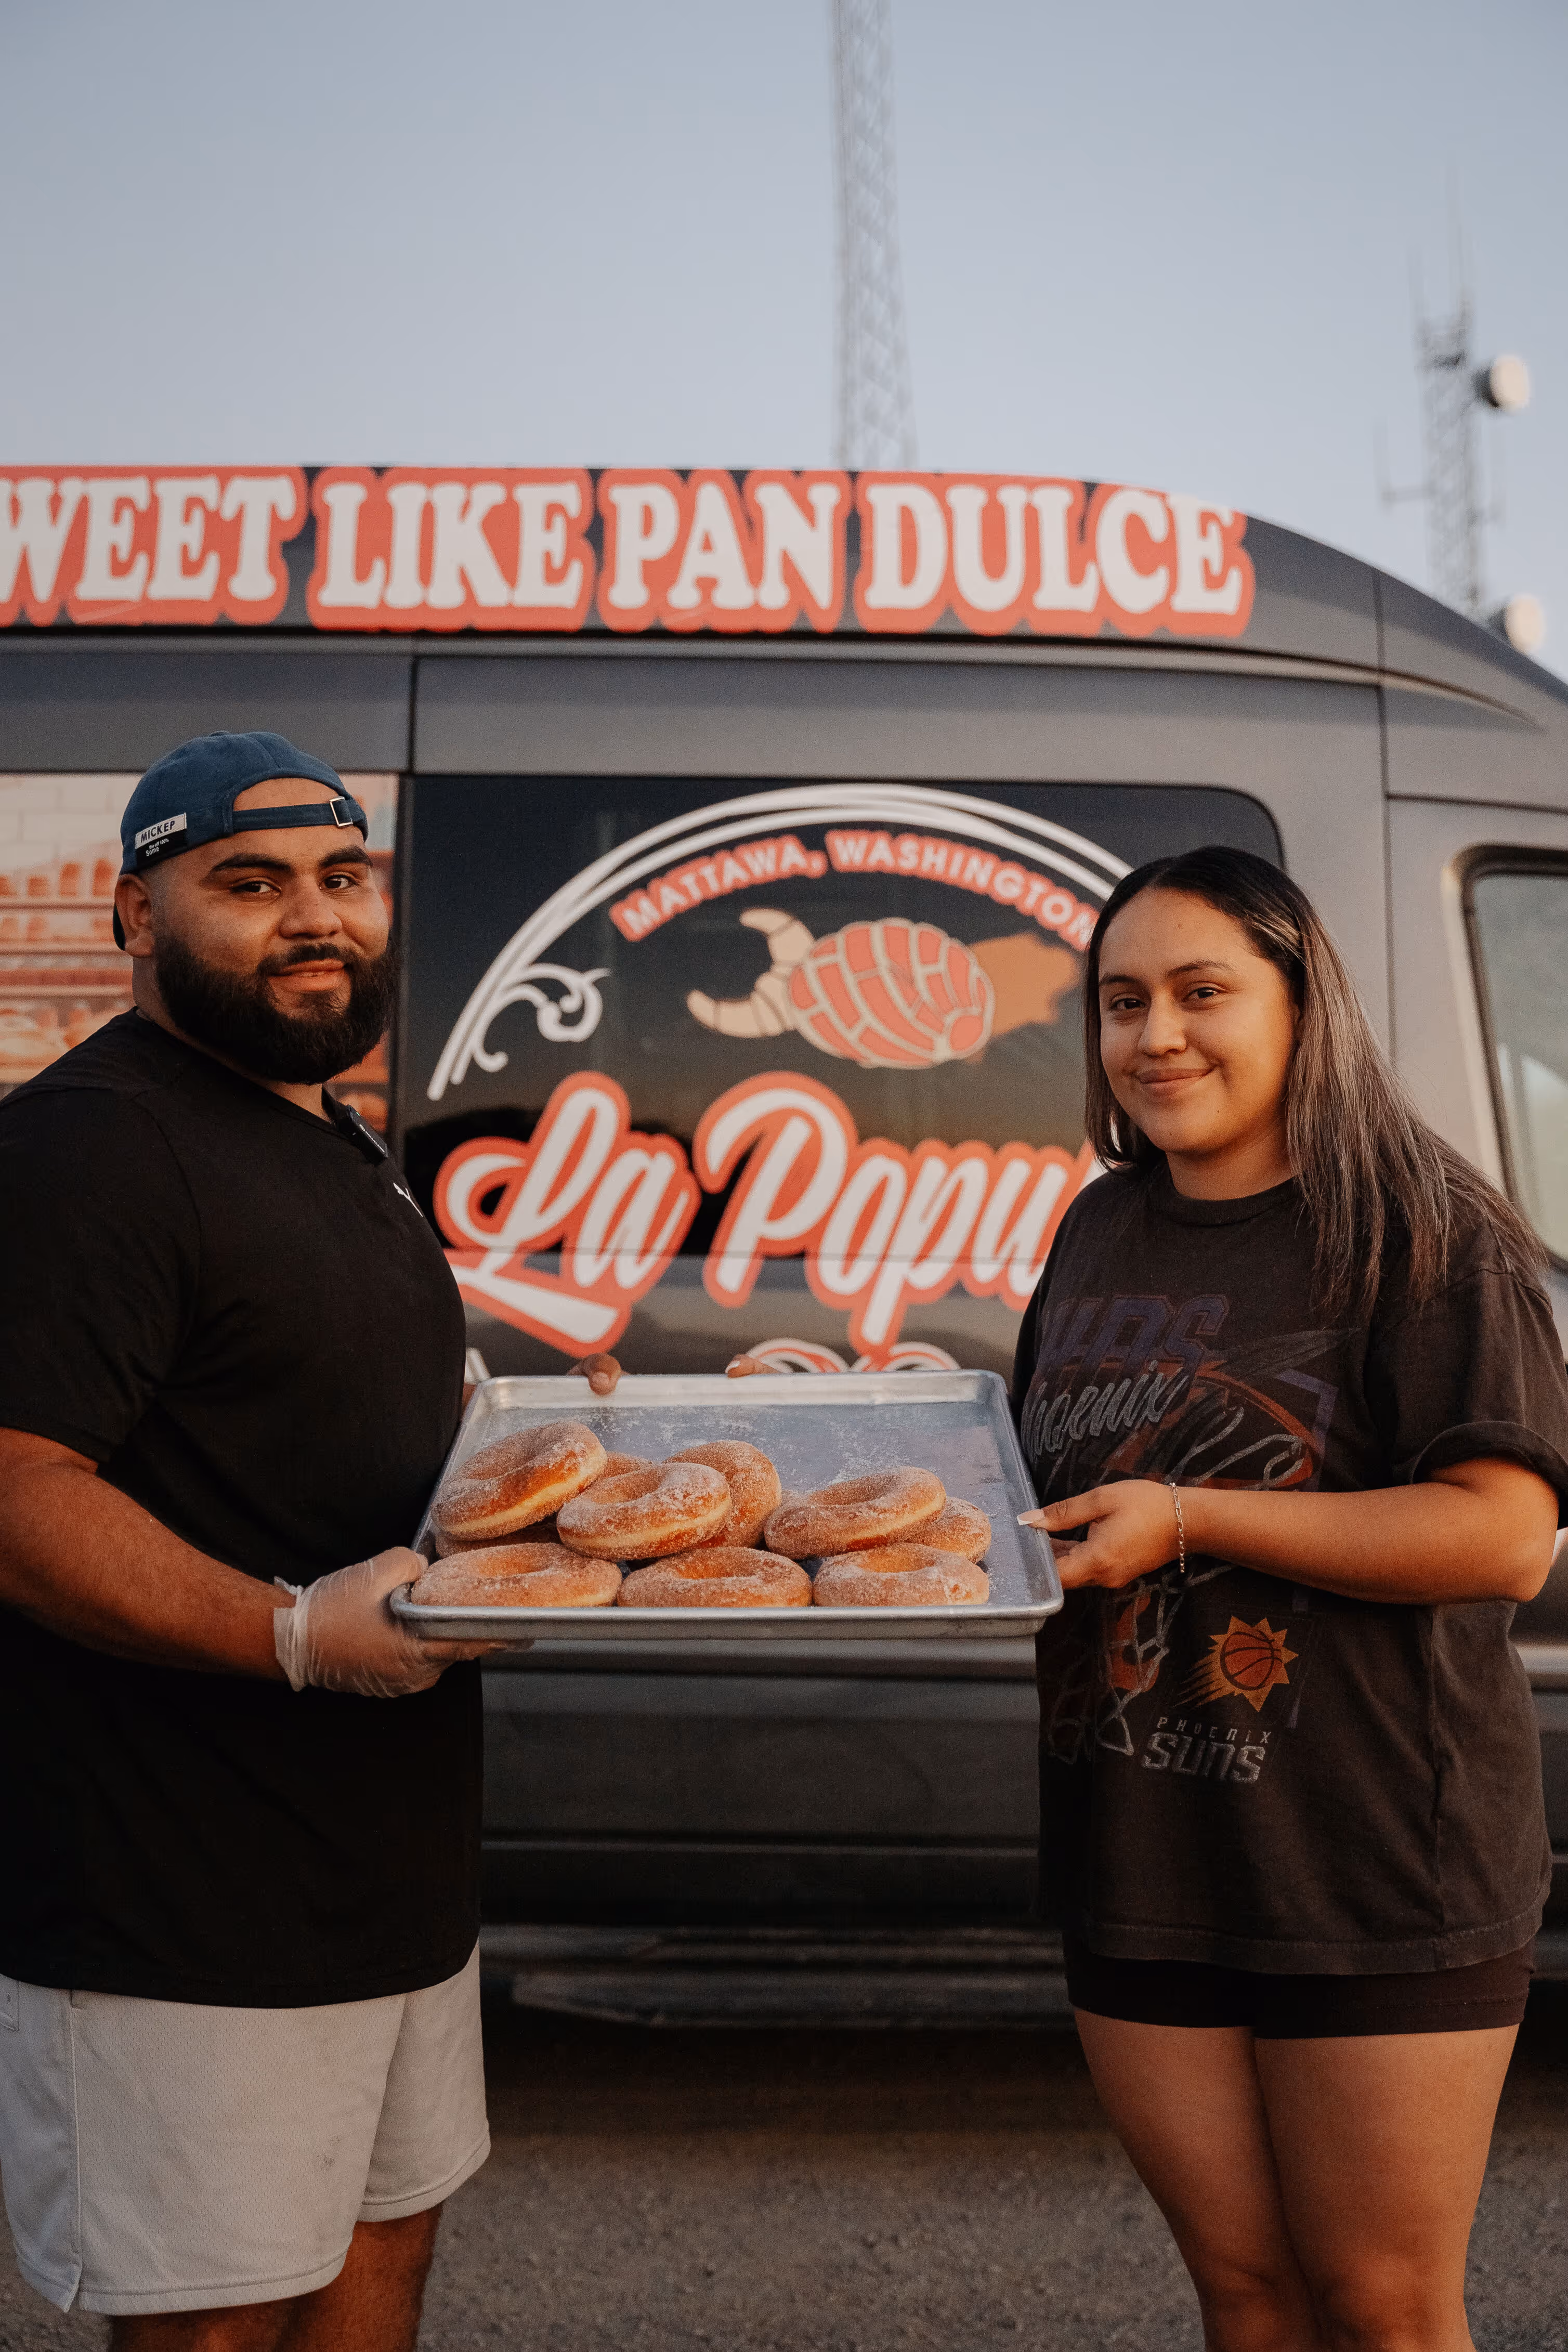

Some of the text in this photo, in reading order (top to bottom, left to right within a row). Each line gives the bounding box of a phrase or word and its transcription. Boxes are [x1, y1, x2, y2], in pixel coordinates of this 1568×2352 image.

[318, 481, 582, 609] LIKE
[607, 482, 840, 611] PAN
[863, 482, 1243, 615] DULCE
[146, 847, 159, 856] Some
[624, 839, 824, 937] MATTAWA,
[445, 1087, 1105, 1345] La Popu
